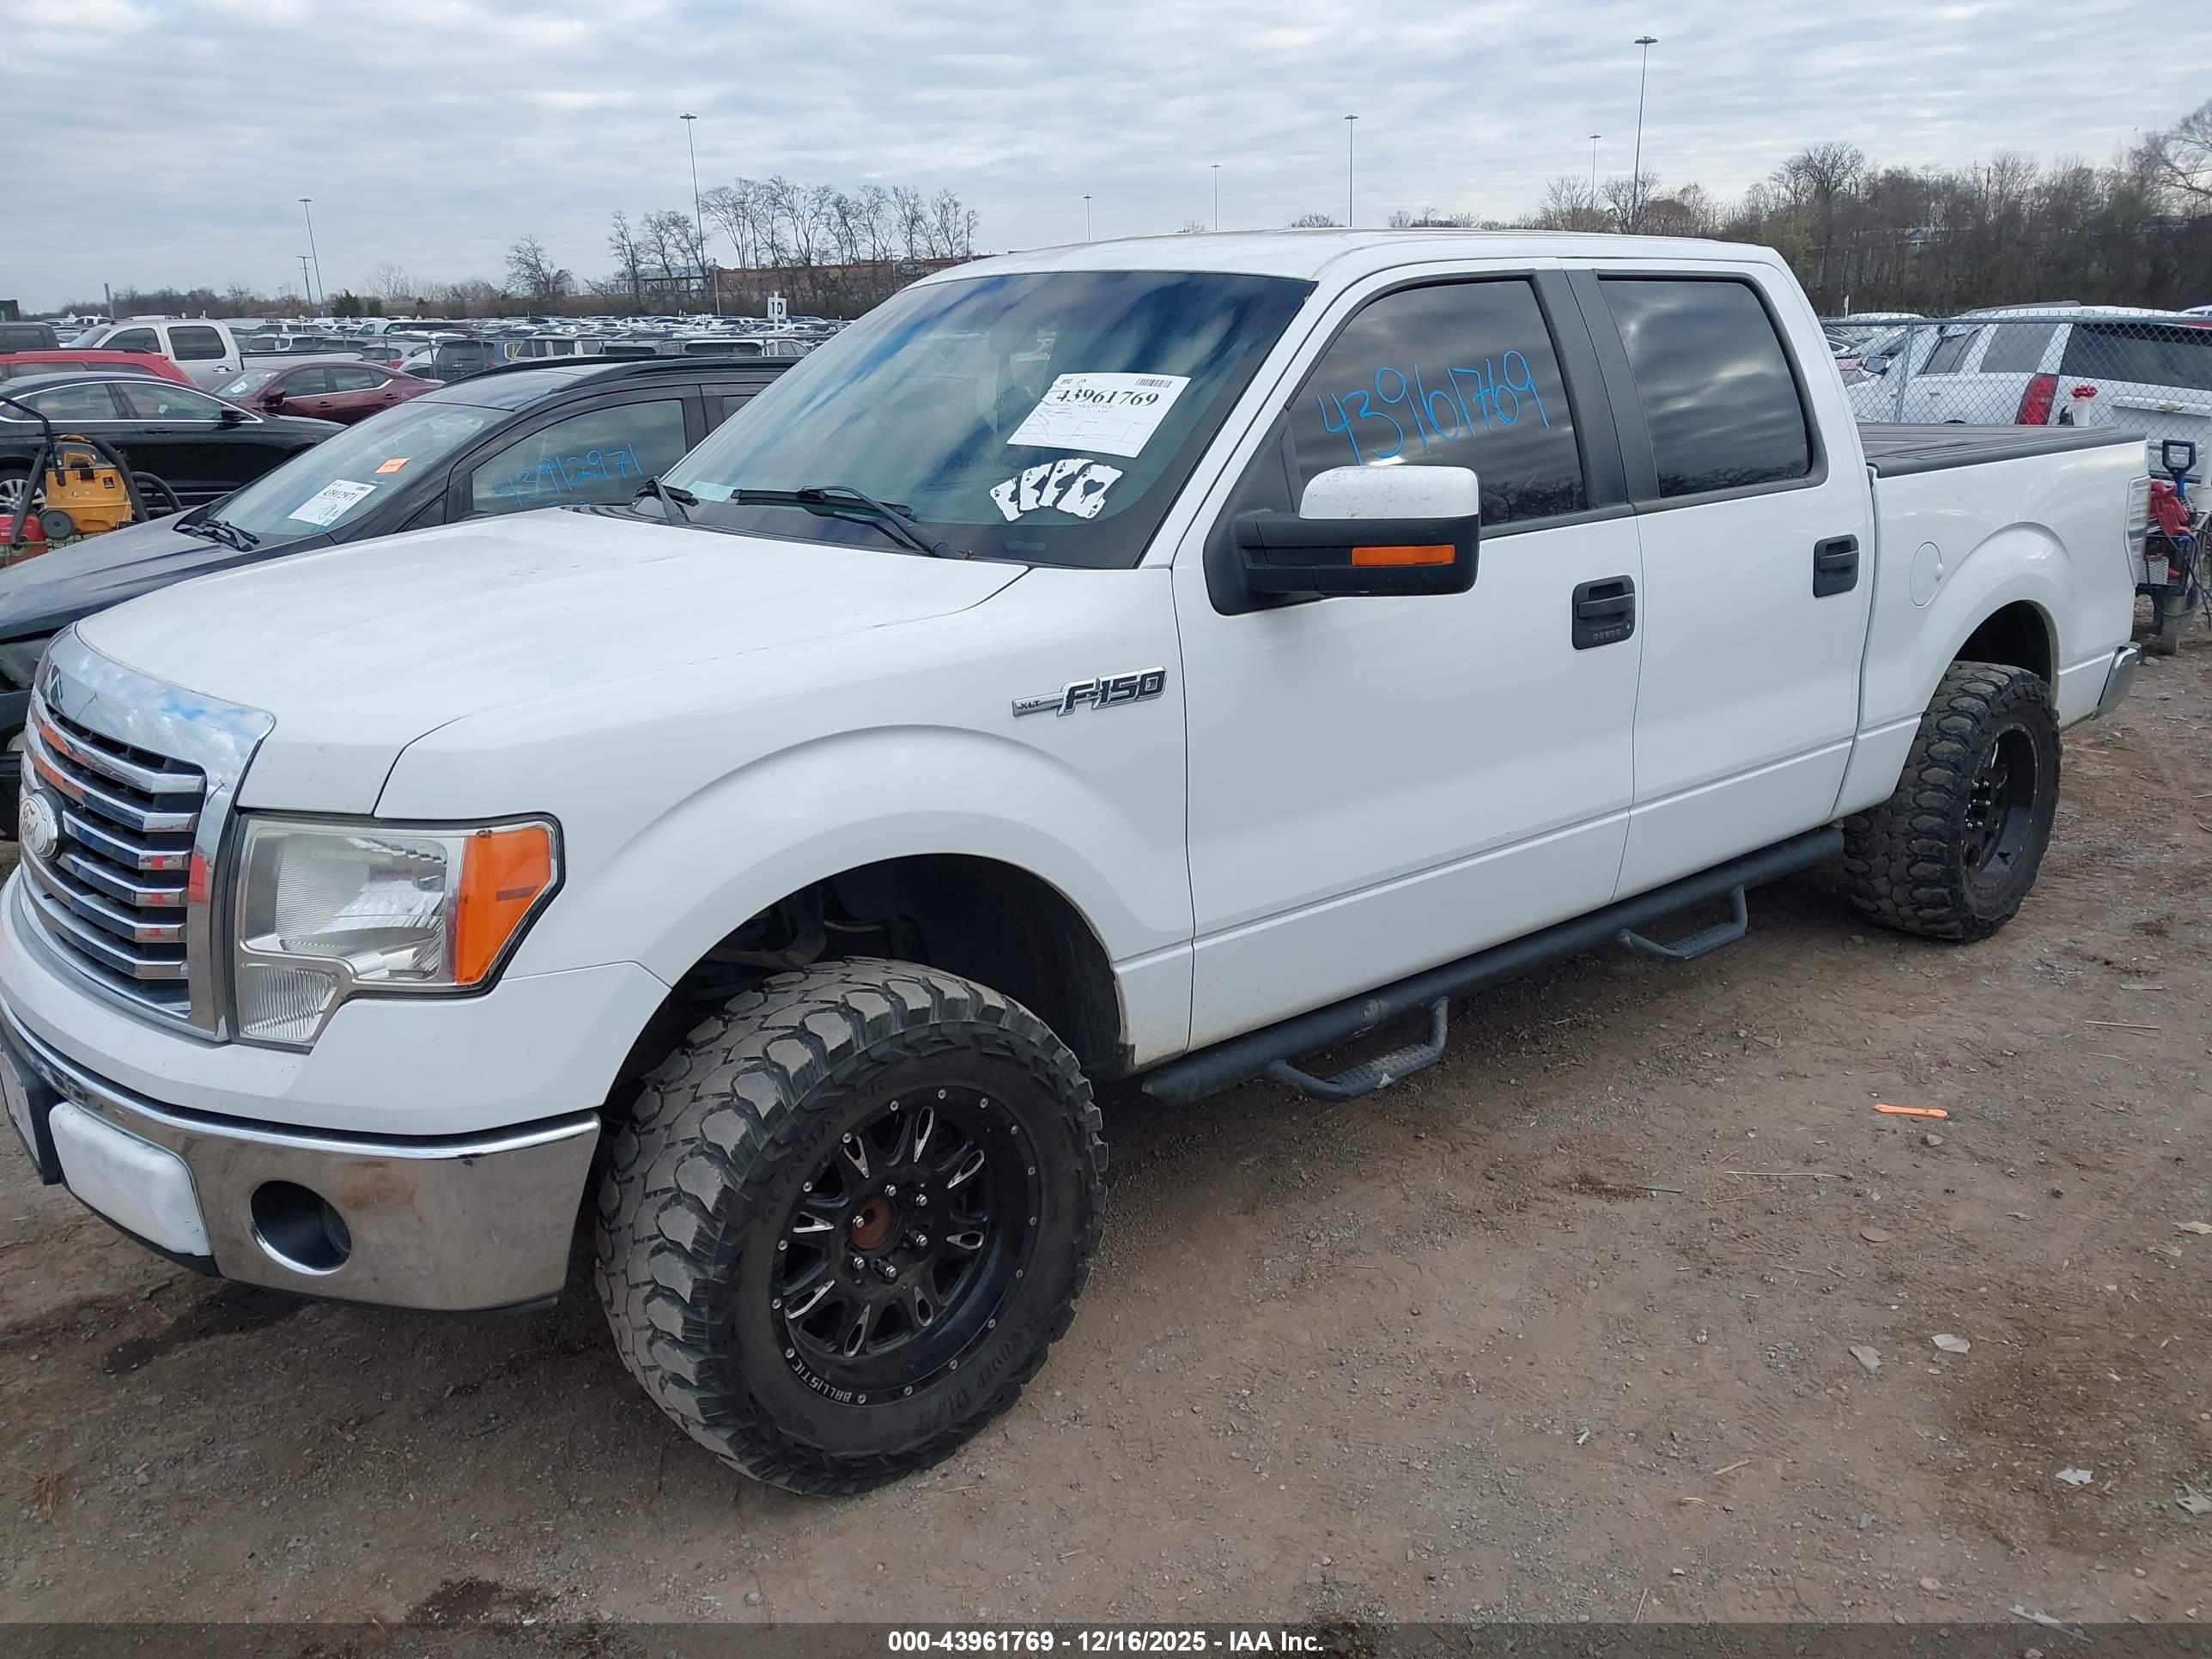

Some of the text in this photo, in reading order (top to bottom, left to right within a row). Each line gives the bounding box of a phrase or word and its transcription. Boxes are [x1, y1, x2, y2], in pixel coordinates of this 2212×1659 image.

[771, 301, 783, 315] 10
[1056, 388, 1160, 407] 43961769
[1317, 349, 1550, 466] 43961769
[494, 443, 643, 508] 43912971
[1020, 665, 1168, 717] XLT F-150
[792, 1358, 853, 1402] BALLISTIC
